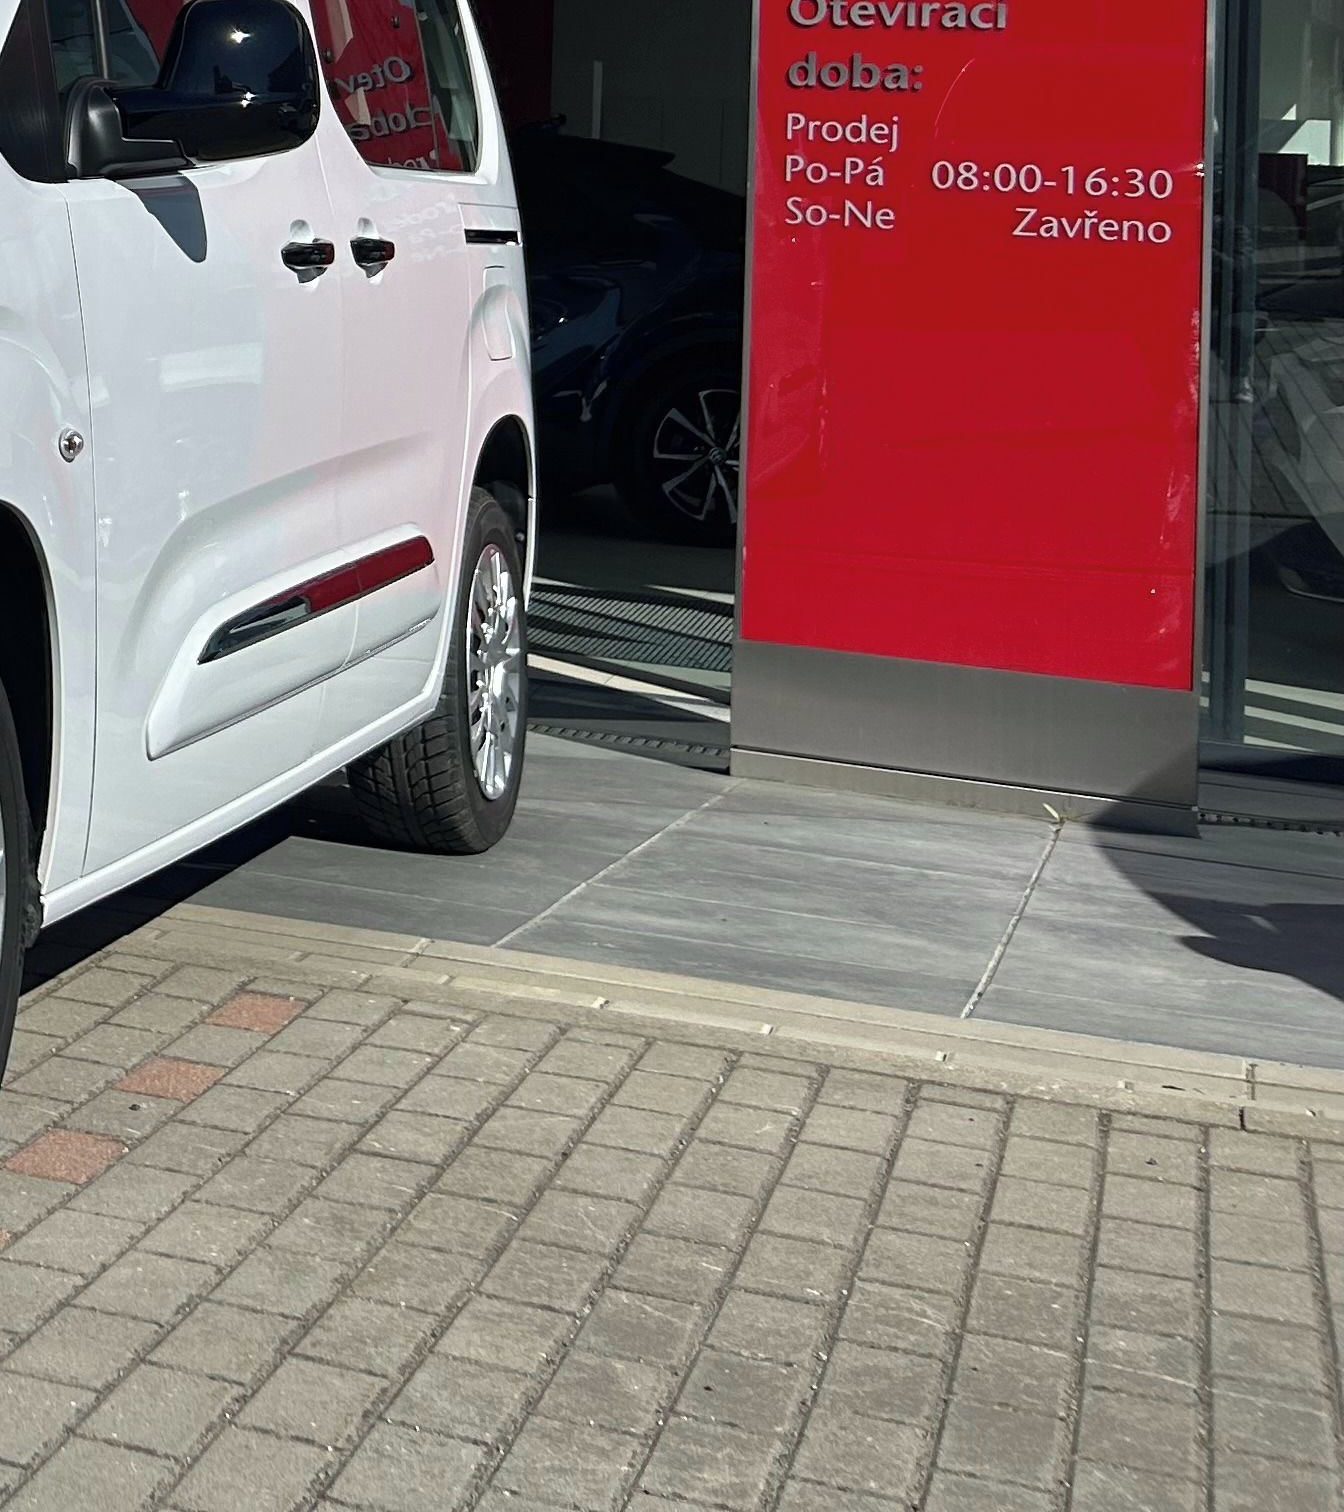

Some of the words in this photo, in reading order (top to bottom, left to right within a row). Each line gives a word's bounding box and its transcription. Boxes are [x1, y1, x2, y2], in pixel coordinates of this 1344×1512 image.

[786, 51, 925, 90] doba:
[785, 112, 900, 153] Prodej
[784, 154, 886, 187] Po-Pá
[931, 159, 1174, 200] 08:00-16:30
[784, 196, 897, 230] So-Ne
[1012, 206, 1173, 245] Zavřeno
